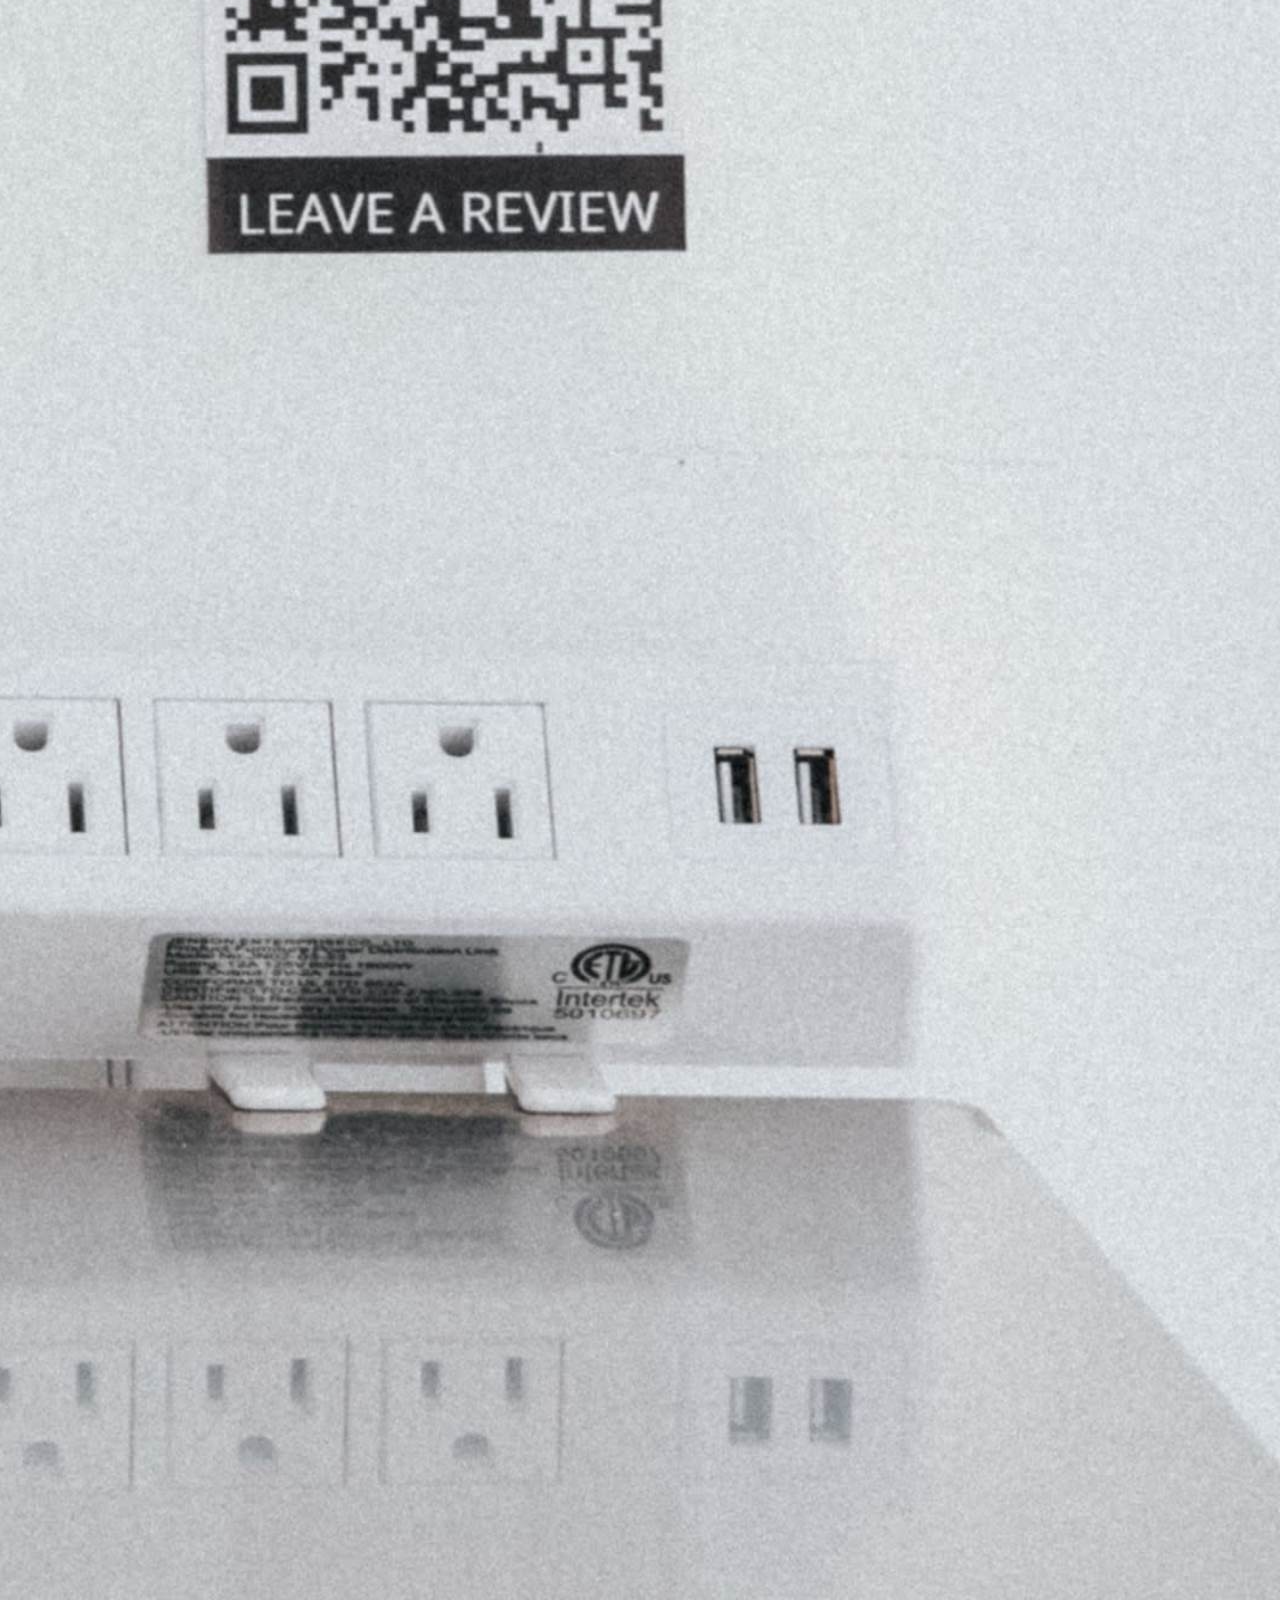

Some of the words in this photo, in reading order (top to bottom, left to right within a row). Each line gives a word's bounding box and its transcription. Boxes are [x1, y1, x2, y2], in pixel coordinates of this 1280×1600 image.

[240, 192, 394, 235] LEAVE
[408, 192, 446, 234] A
[462, 190, 660, 234] REVIEW
[648, 972, 672, 986] US
[555, 989, 661, 1008] Intertek
